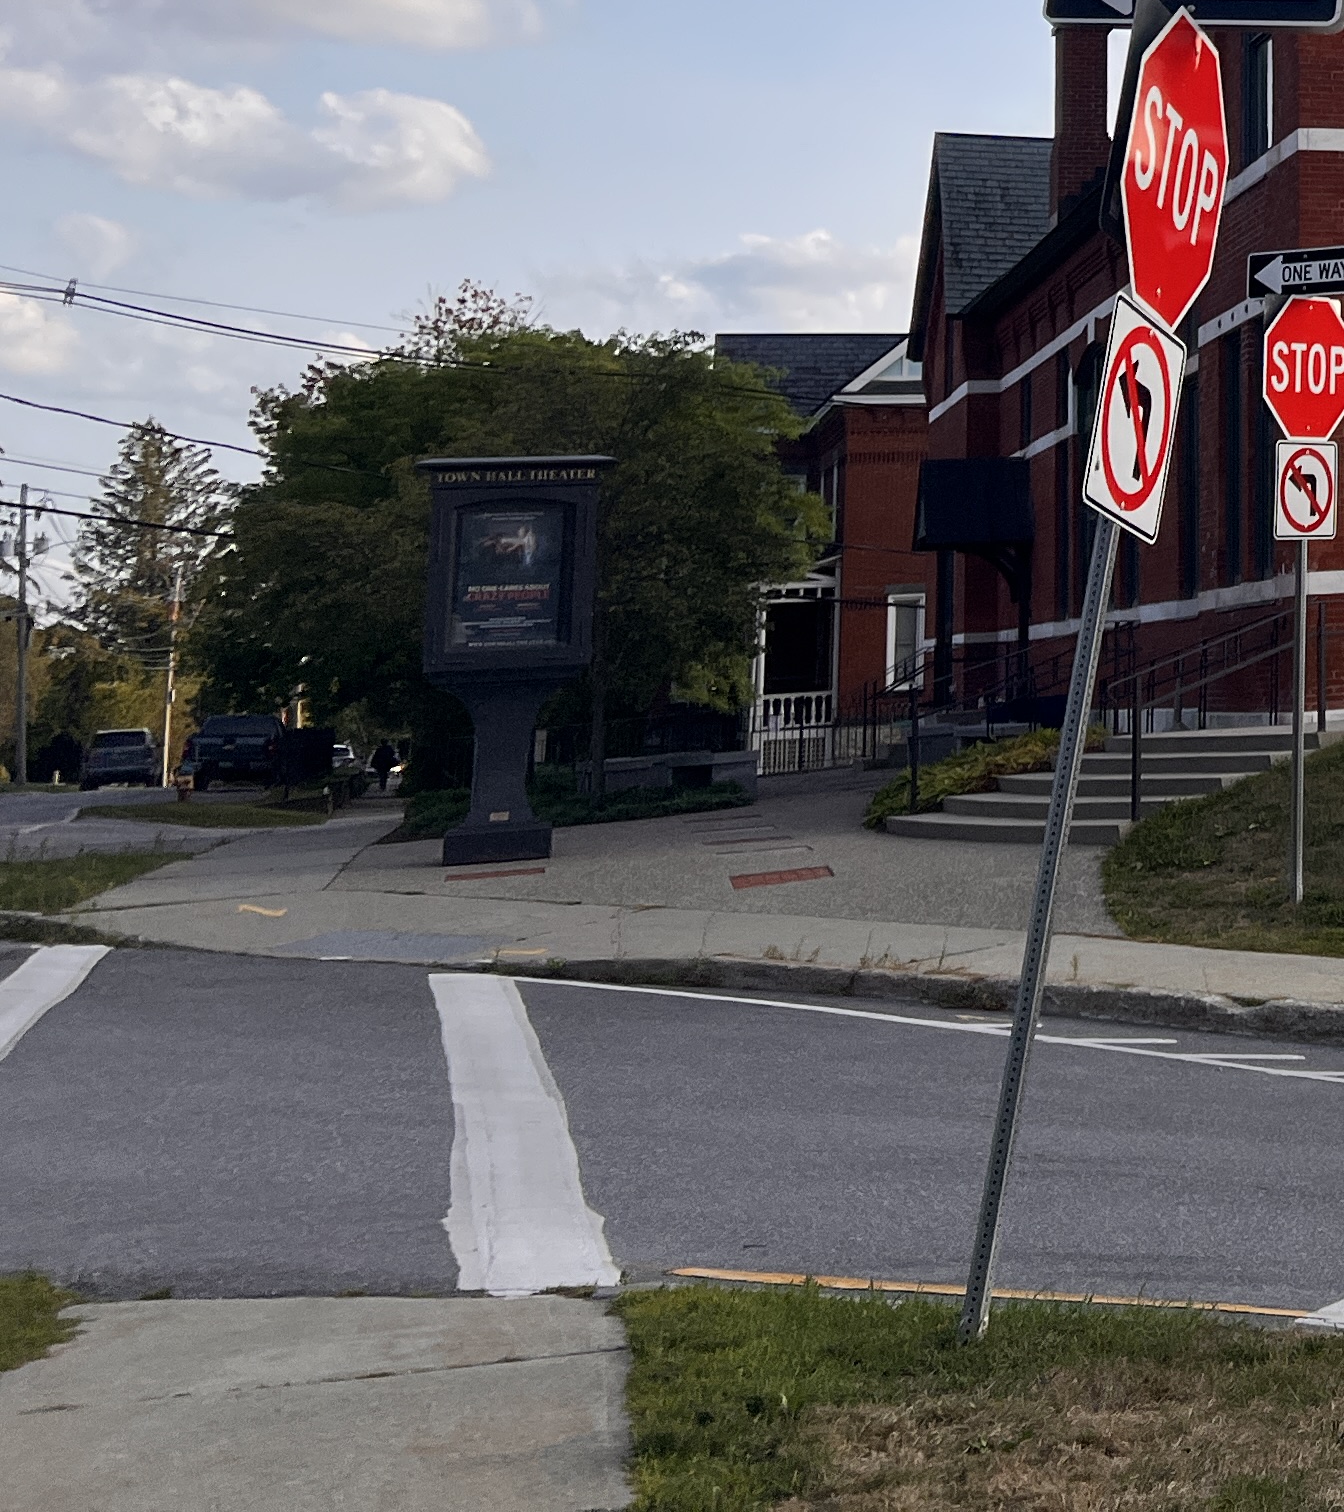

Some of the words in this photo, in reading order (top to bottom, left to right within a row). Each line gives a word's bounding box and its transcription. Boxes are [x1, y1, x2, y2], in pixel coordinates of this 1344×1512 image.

[1135, 85, 1218, 246] STOP
[1282, 264, 1312, 282] ONE
[437, 471, 481, 483] TOWN
[486, 470, 525, 481] HALL
[530, 468, 596, 480] THEATER
